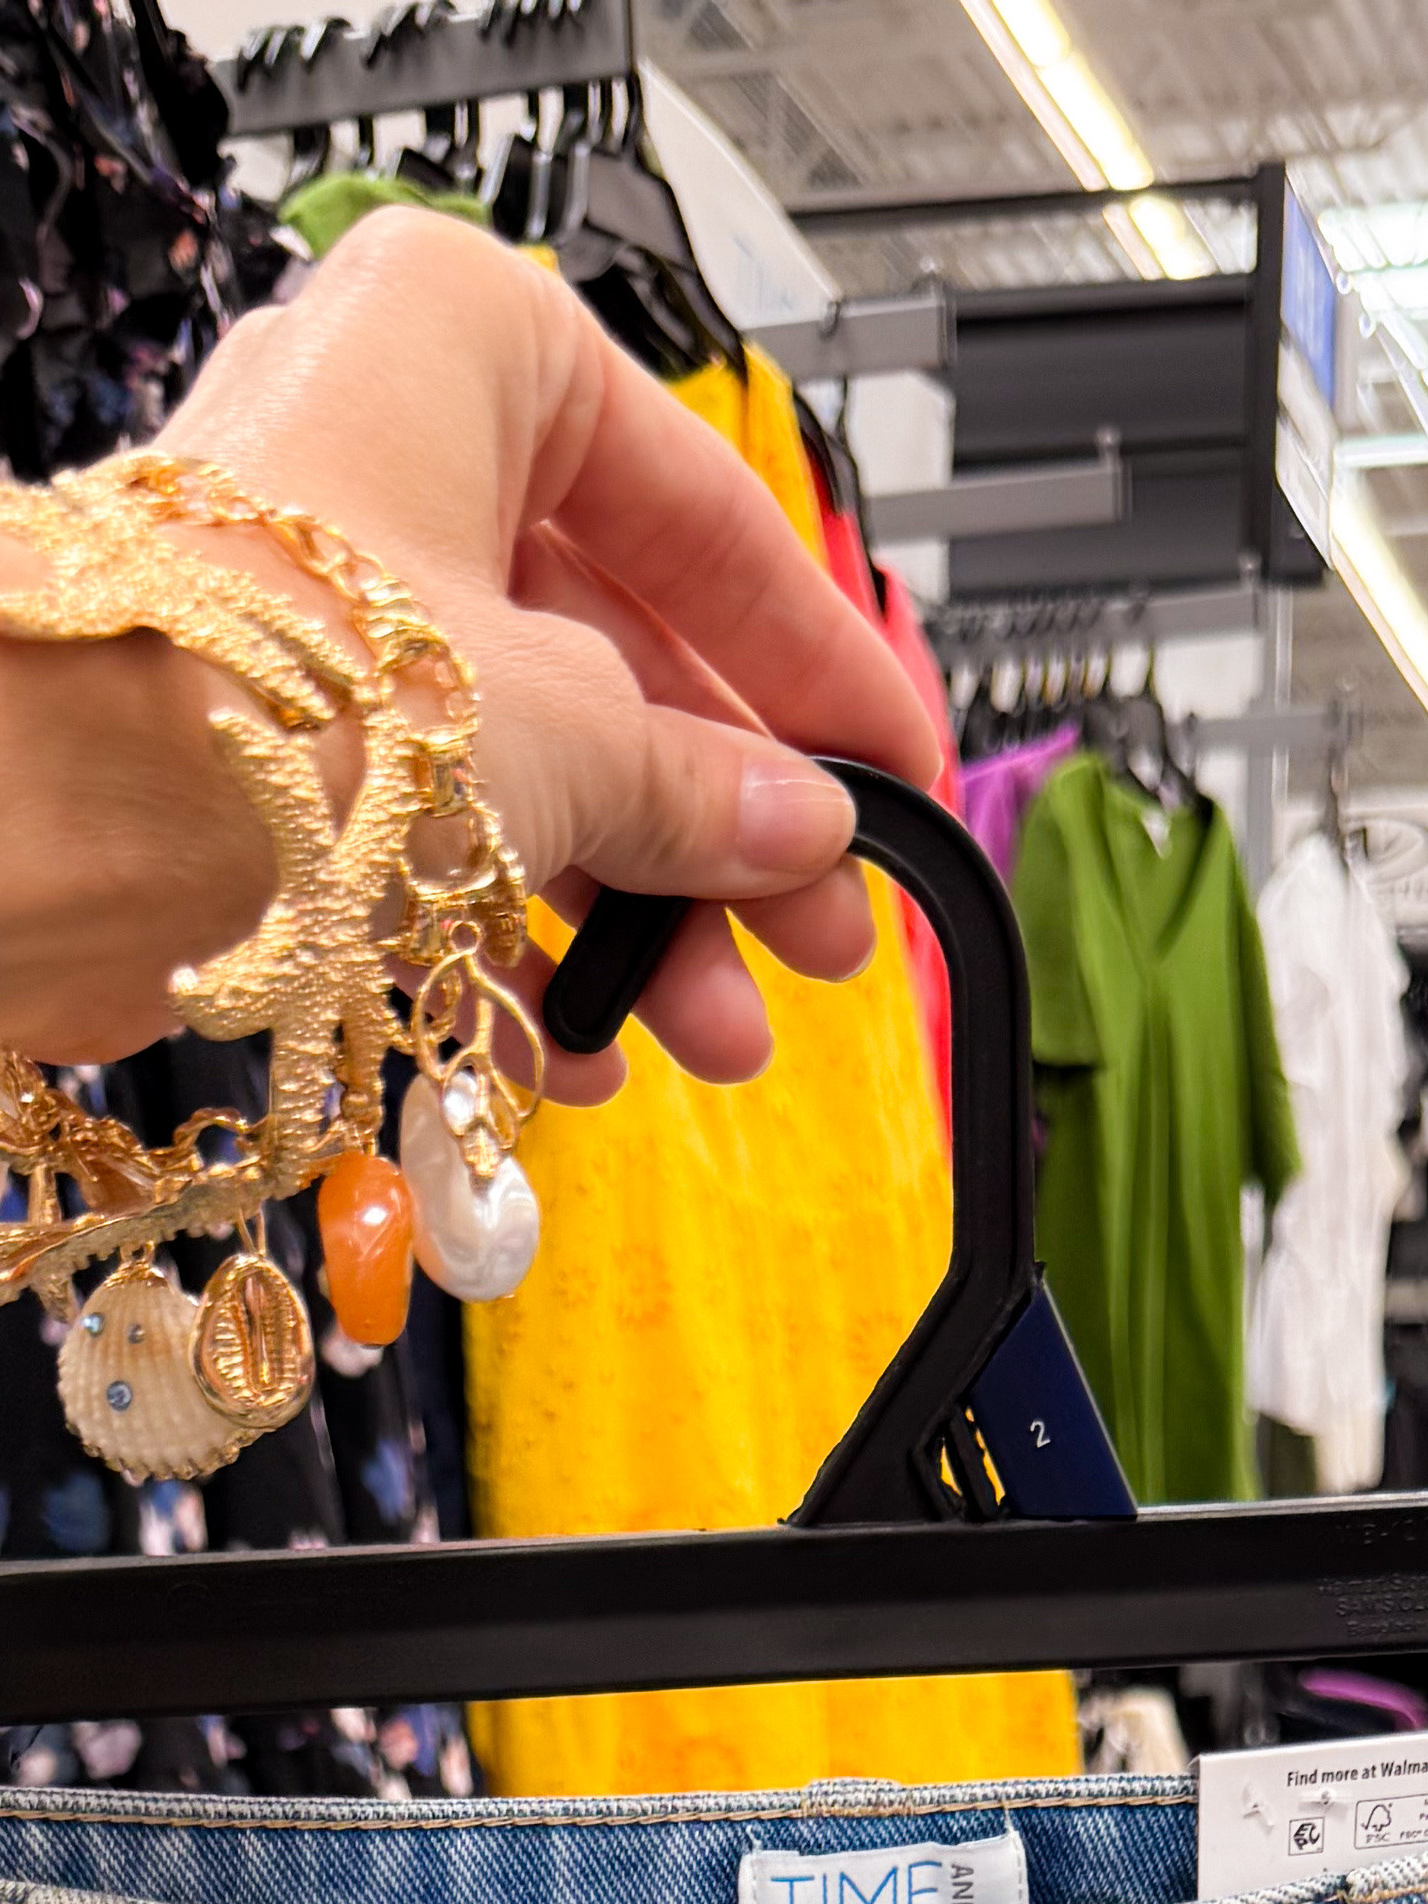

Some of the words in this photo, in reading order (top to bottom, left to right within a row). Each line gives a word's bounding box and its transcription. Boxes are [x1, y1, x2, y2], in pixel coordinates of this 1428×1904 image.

[1029, 1418, 1051, 1449] 2
[1286, 1769, 1319, 1788] Find
[1321, 1768, 1360, 1784] more
[1361, 1764, 1378, 1780] at
